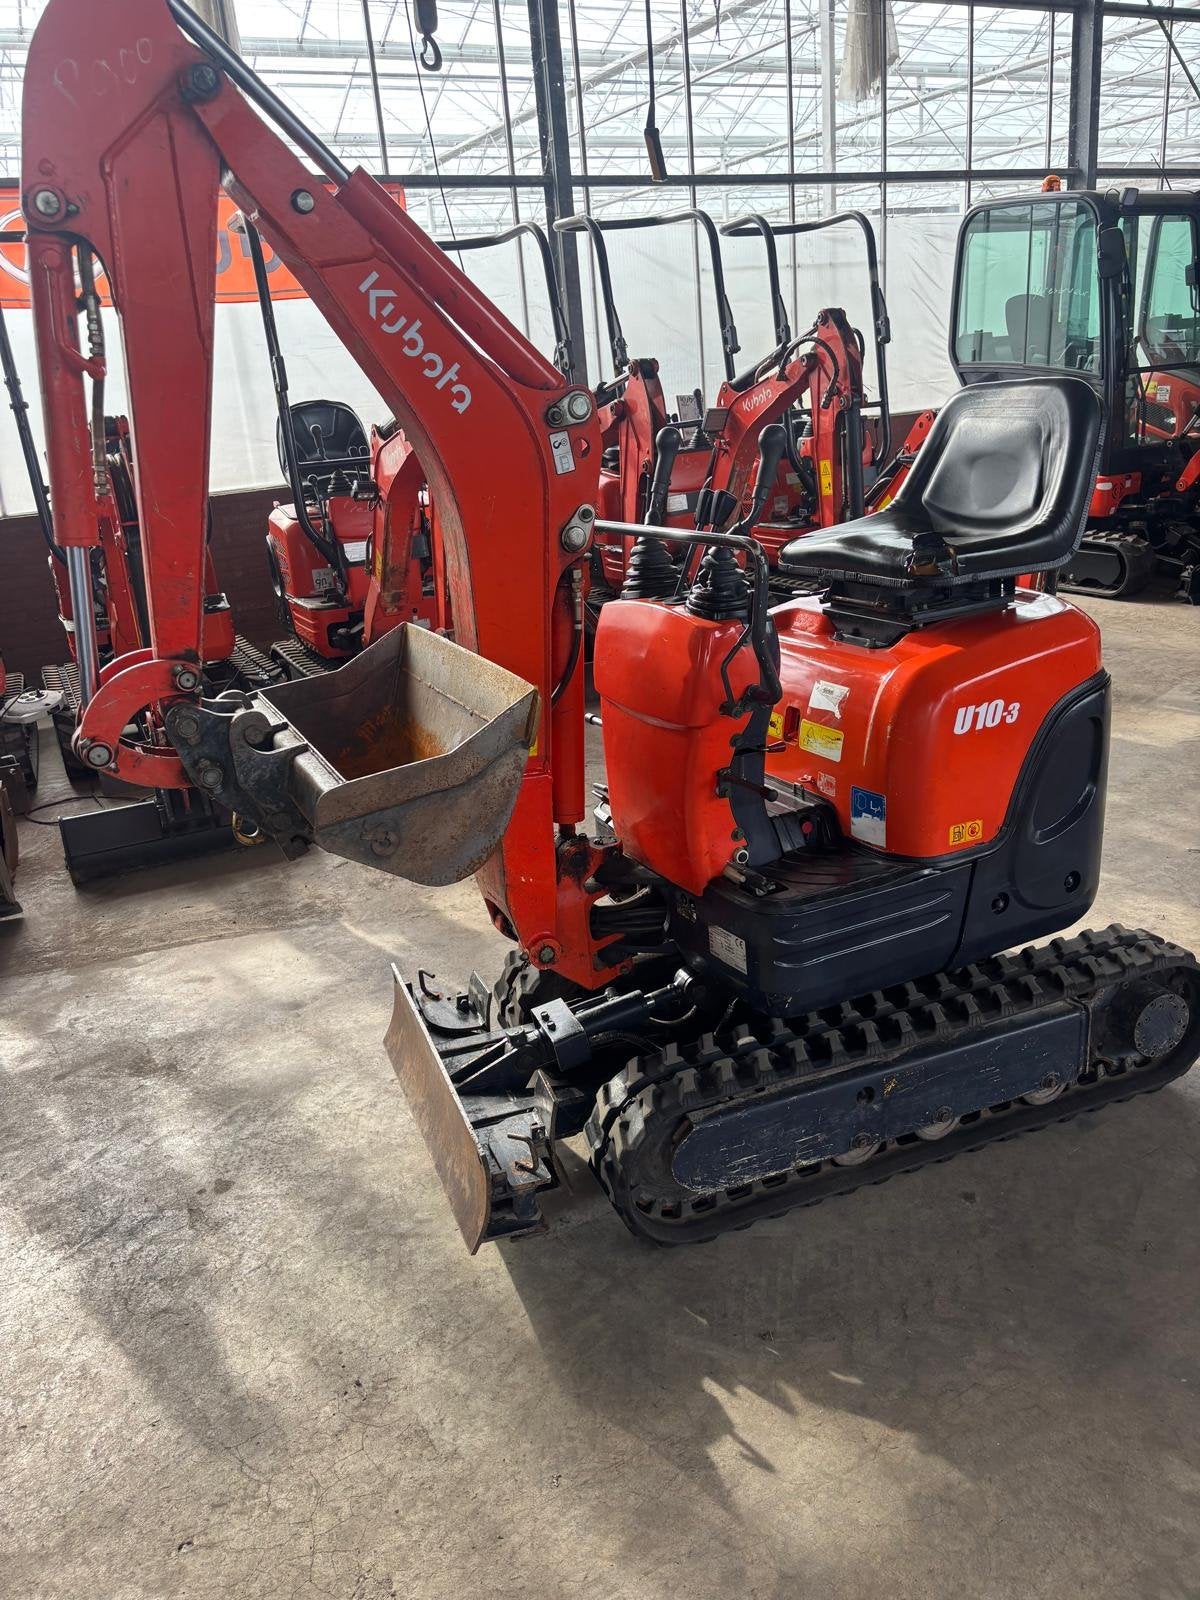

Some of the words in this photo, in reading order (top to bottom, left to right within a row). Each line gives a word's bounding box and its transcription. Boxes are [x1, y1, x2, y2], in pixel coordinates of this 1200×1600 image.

[358, 271, 472, 415] Kubota
[742, 387, 772, 412] Kubota
[953, 699, 1020, 735] U10-3
